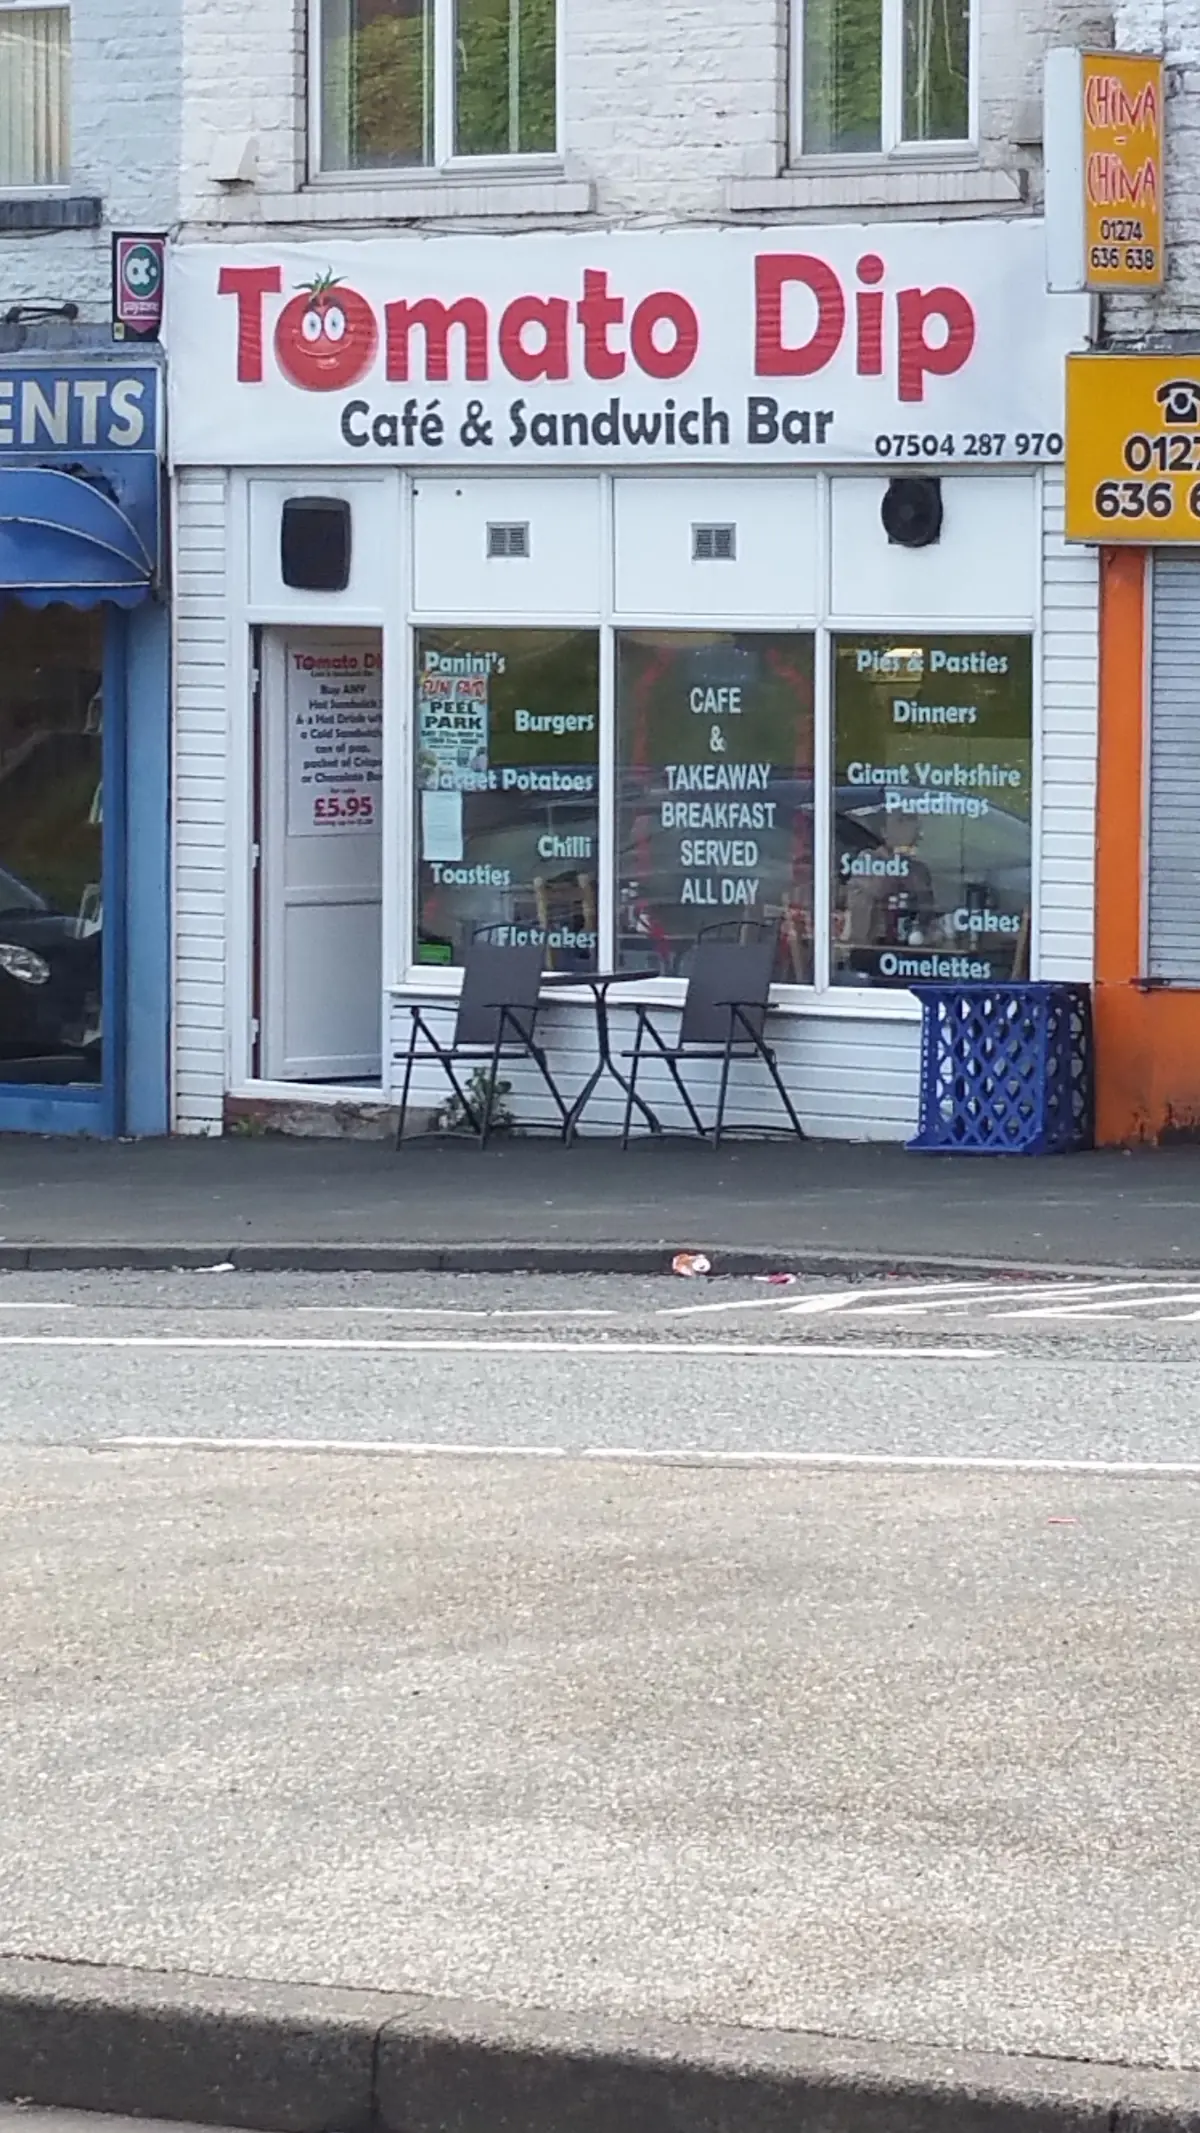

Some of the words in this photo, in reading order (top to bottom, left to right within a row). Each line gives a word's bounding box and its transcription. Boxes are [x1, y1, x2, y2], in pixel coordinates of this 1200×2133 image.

[1100, 219, 1143, 241] 01274
[1090, 247, 1119, 269] 636
[1125, 248, 1155, 270] 638
[217, 264, 699, 392] Tomato
[754, 253, 976, 402] Dip
[341, 399, 443, 447] Café
[459, 399, 494, 447] &
[510, 396, 729, 447] Sandwich
[747, 397, 834, 445] Bar
[874, 433, 955, 457] 07504
[963, 433, 1006, 456] 287
[1015, 432, 1064, 456] 970
[1094, 480, 1173, 519] 636
[424, 651, 505, 674] Panini's
[856, 649, 900, 672] Pies
[930, 649, 1009, 674] Pasties
[430, 700, 478, 715] PEEL
[690, 687, 743, 714] CAFE
[893, 700, 977, 724] Dinners
[425, 716, 482, 730] PARK
[515, 709, 594, 735] Burgers
[709, 725, 726, 752] &
[502, 768, 593, 792] Potatoes
[665, 763, 772, 791] TAKEAWAY
[847, 762, 910, 785] Giant
[915, 762, 1021, 787] Yorkshire
[314, 796, 373, 818] £5.95
[661, 801, 777, 829] BREAKFAST
[884, 791, 989, 818] Puddings
[538, 835, 592, 858] Chilli
[680, 839, 759, 867] SERVED
[430, 863, 510, 886] Toasties
[840, 852, 910, 876] Salads
[680, 878, 718, 905] ALL
[721, 879, 760, 905] DAY
[953, 908, 1021, 933] Cakes
[879, 953, 992, 979] Omelettes
